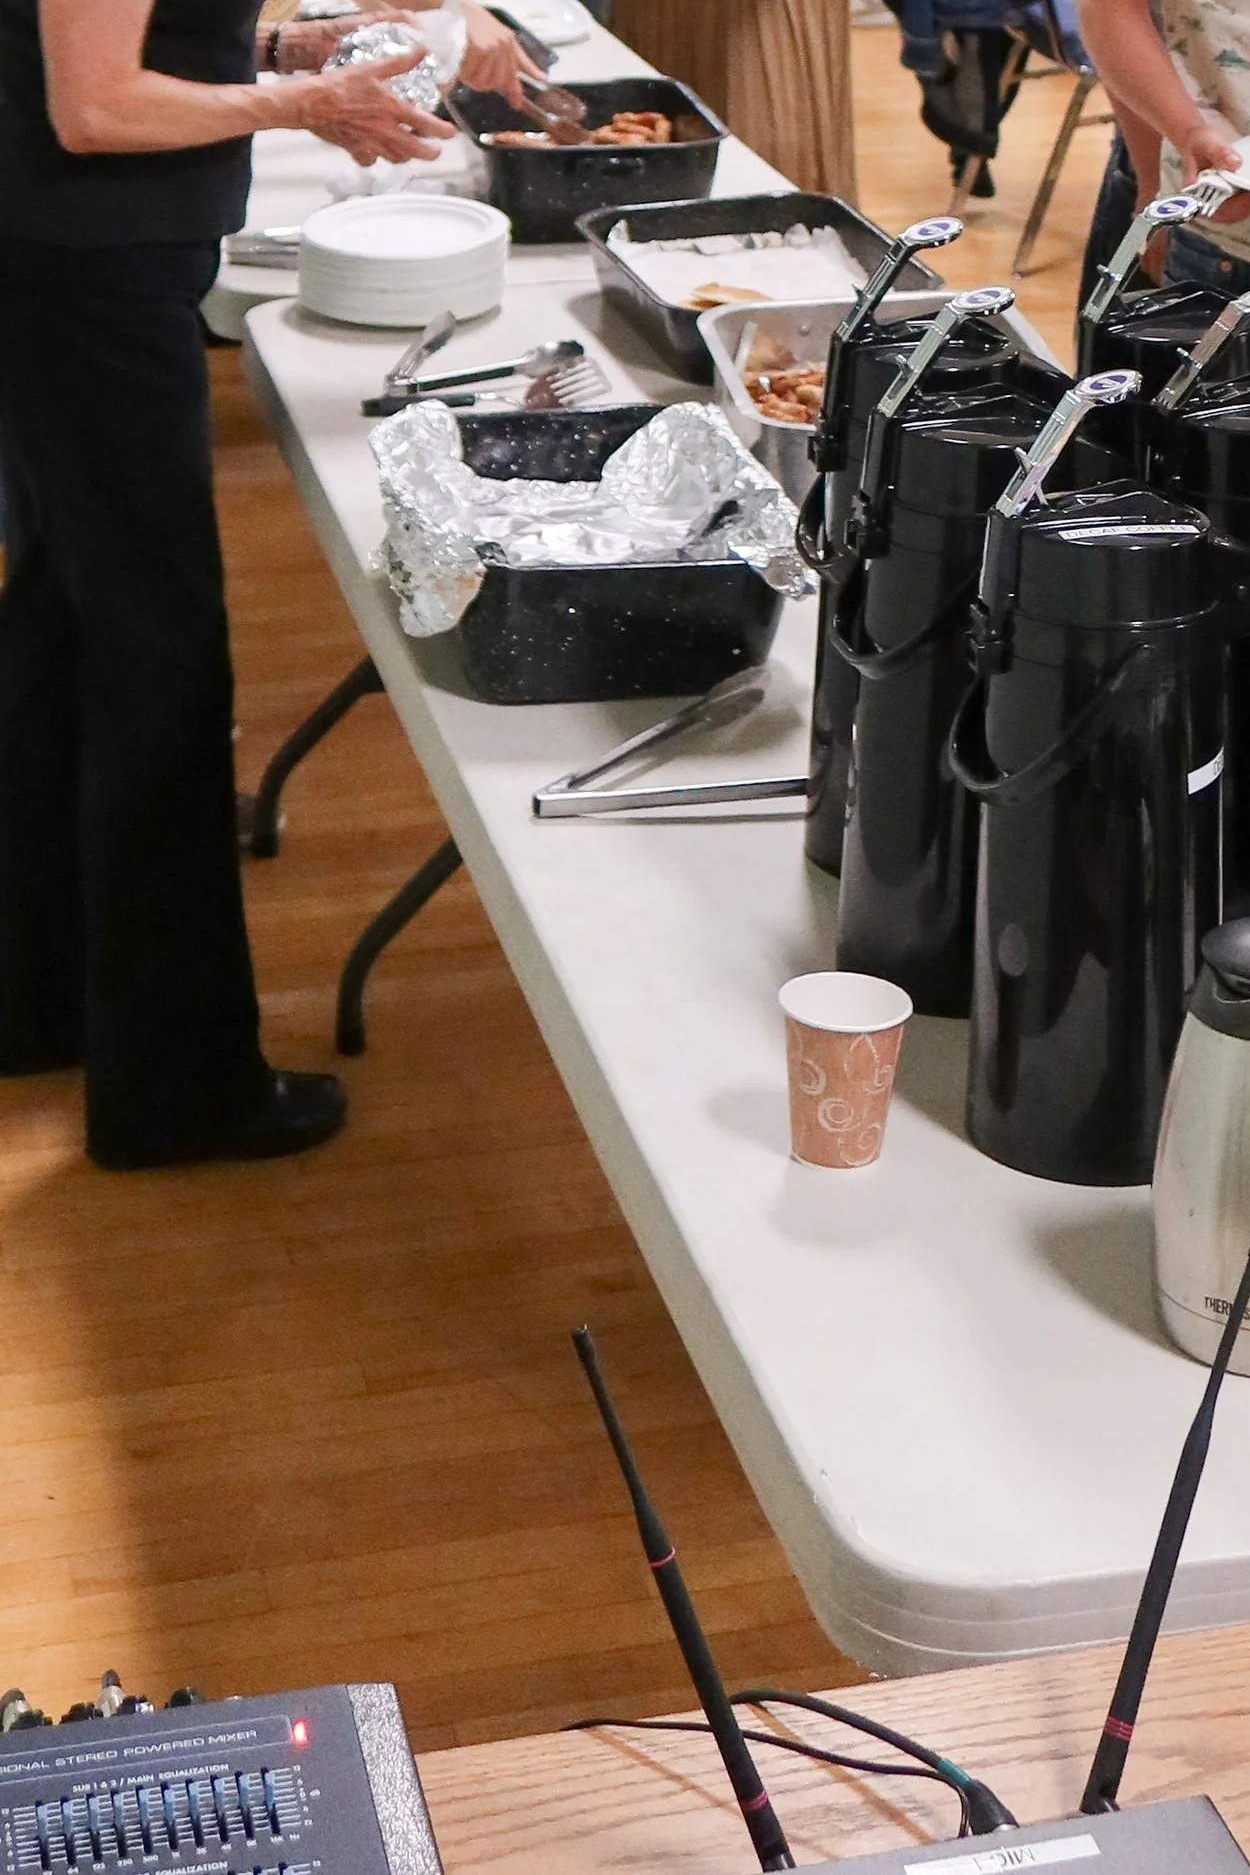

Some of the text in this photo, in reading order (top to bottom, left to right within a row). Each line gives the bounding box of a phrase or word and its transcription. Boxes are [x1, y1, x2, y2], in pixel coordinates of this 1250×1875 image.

[1066, 527, 1118, 538] DECAF
[1204, 1296, 1250, 1321] THERS
[55, 1750, 118, 1767] STEREO
[123, 1737, 205, 1757] POWERED
[208, 1729, 258, 1745] MIXER
[127, 1773, 154, 1785] MAIN
[159, 1763, 229, 1780] EQUALIZATION
